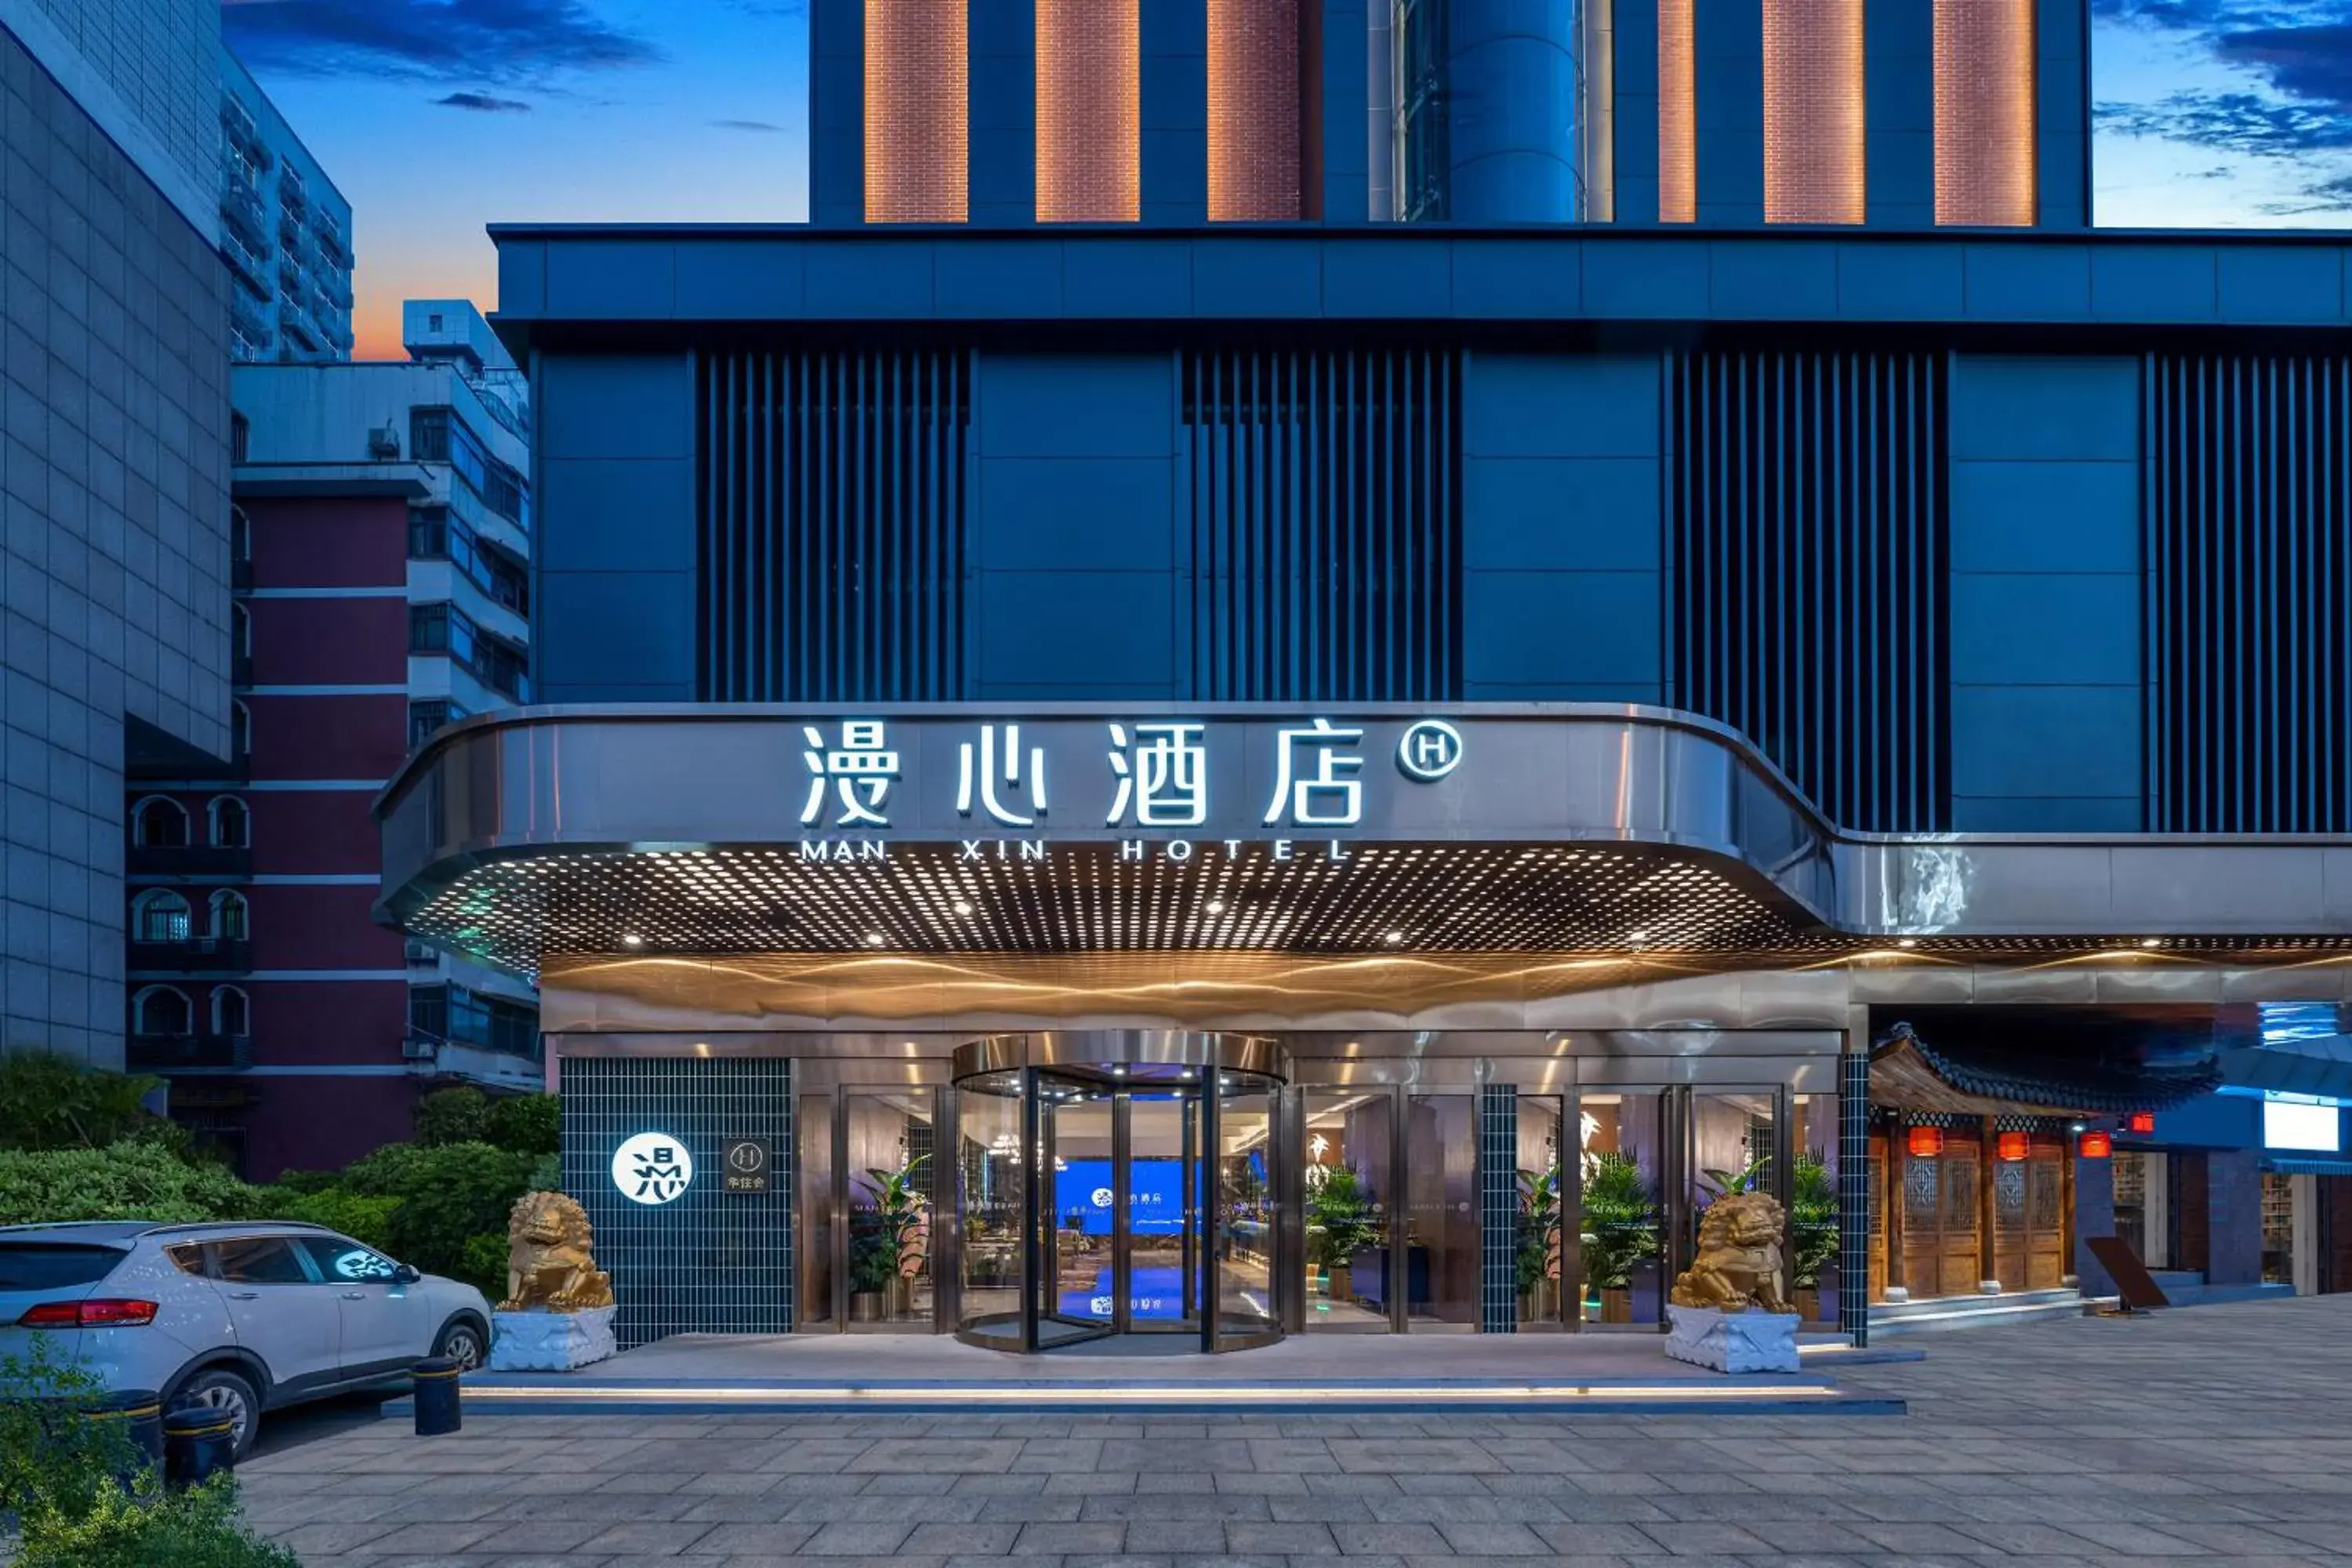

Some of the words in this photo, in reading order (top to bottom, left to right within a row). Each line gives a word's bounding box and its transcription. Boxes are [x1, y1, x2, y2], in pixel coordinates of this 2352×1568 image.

[800, 718, 1364, 825] 漫心酒店
[800, 840, 885, 861] MAN
[962, 840, 1044, 861] XIN
[1121, 840, 1348, 861] HOTEL
